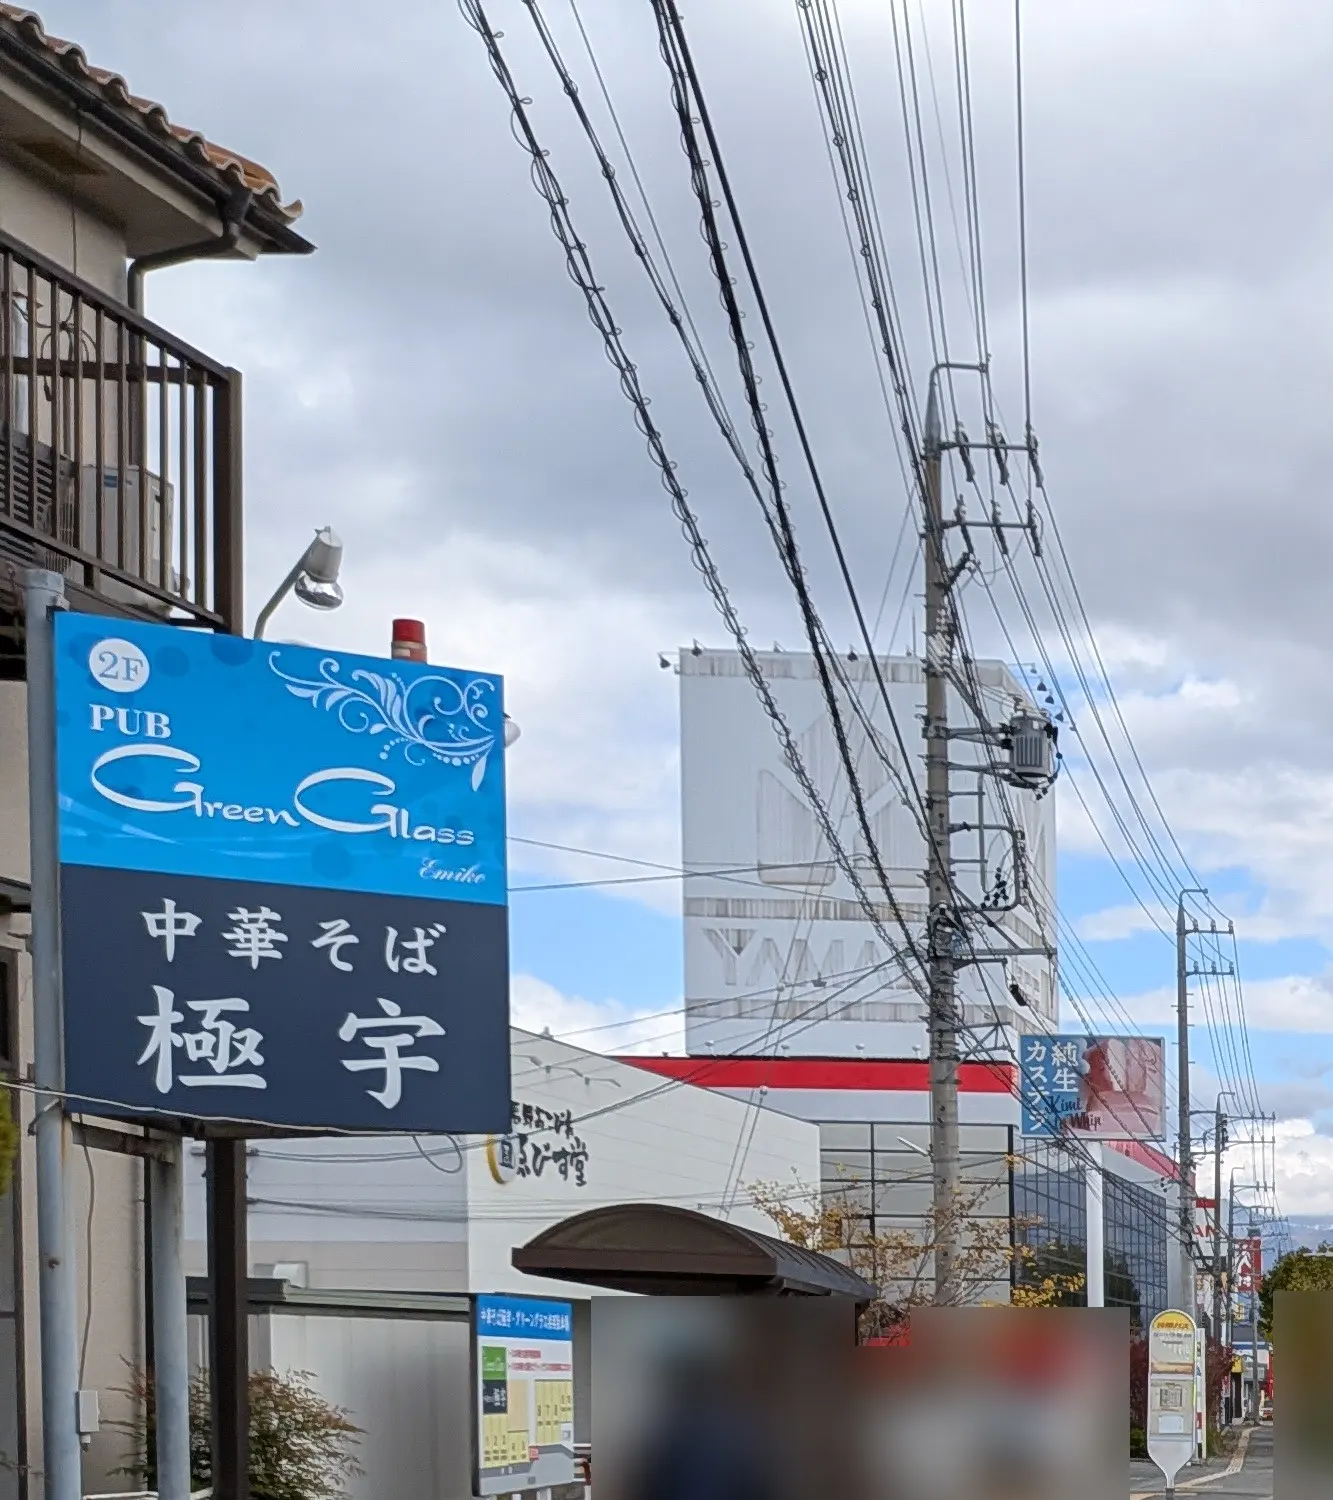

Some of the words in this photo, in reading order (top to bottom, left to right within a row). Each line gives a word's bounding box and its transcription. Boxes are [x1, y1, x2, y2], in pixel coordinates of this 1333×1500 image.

[97, 650, 144, 682] 2F
[89, 703, 172, 740] PUB
[90, 743, 300, 828] Green
[294, 766, 475, 847] Glass
[141, 897, 446, 978] 中華そば
[136, 984, 446, 1110] 極宇
[1025, 1041, 1050, 1131] カステラ
[1051, 1041, 1079, 1092] 純生
